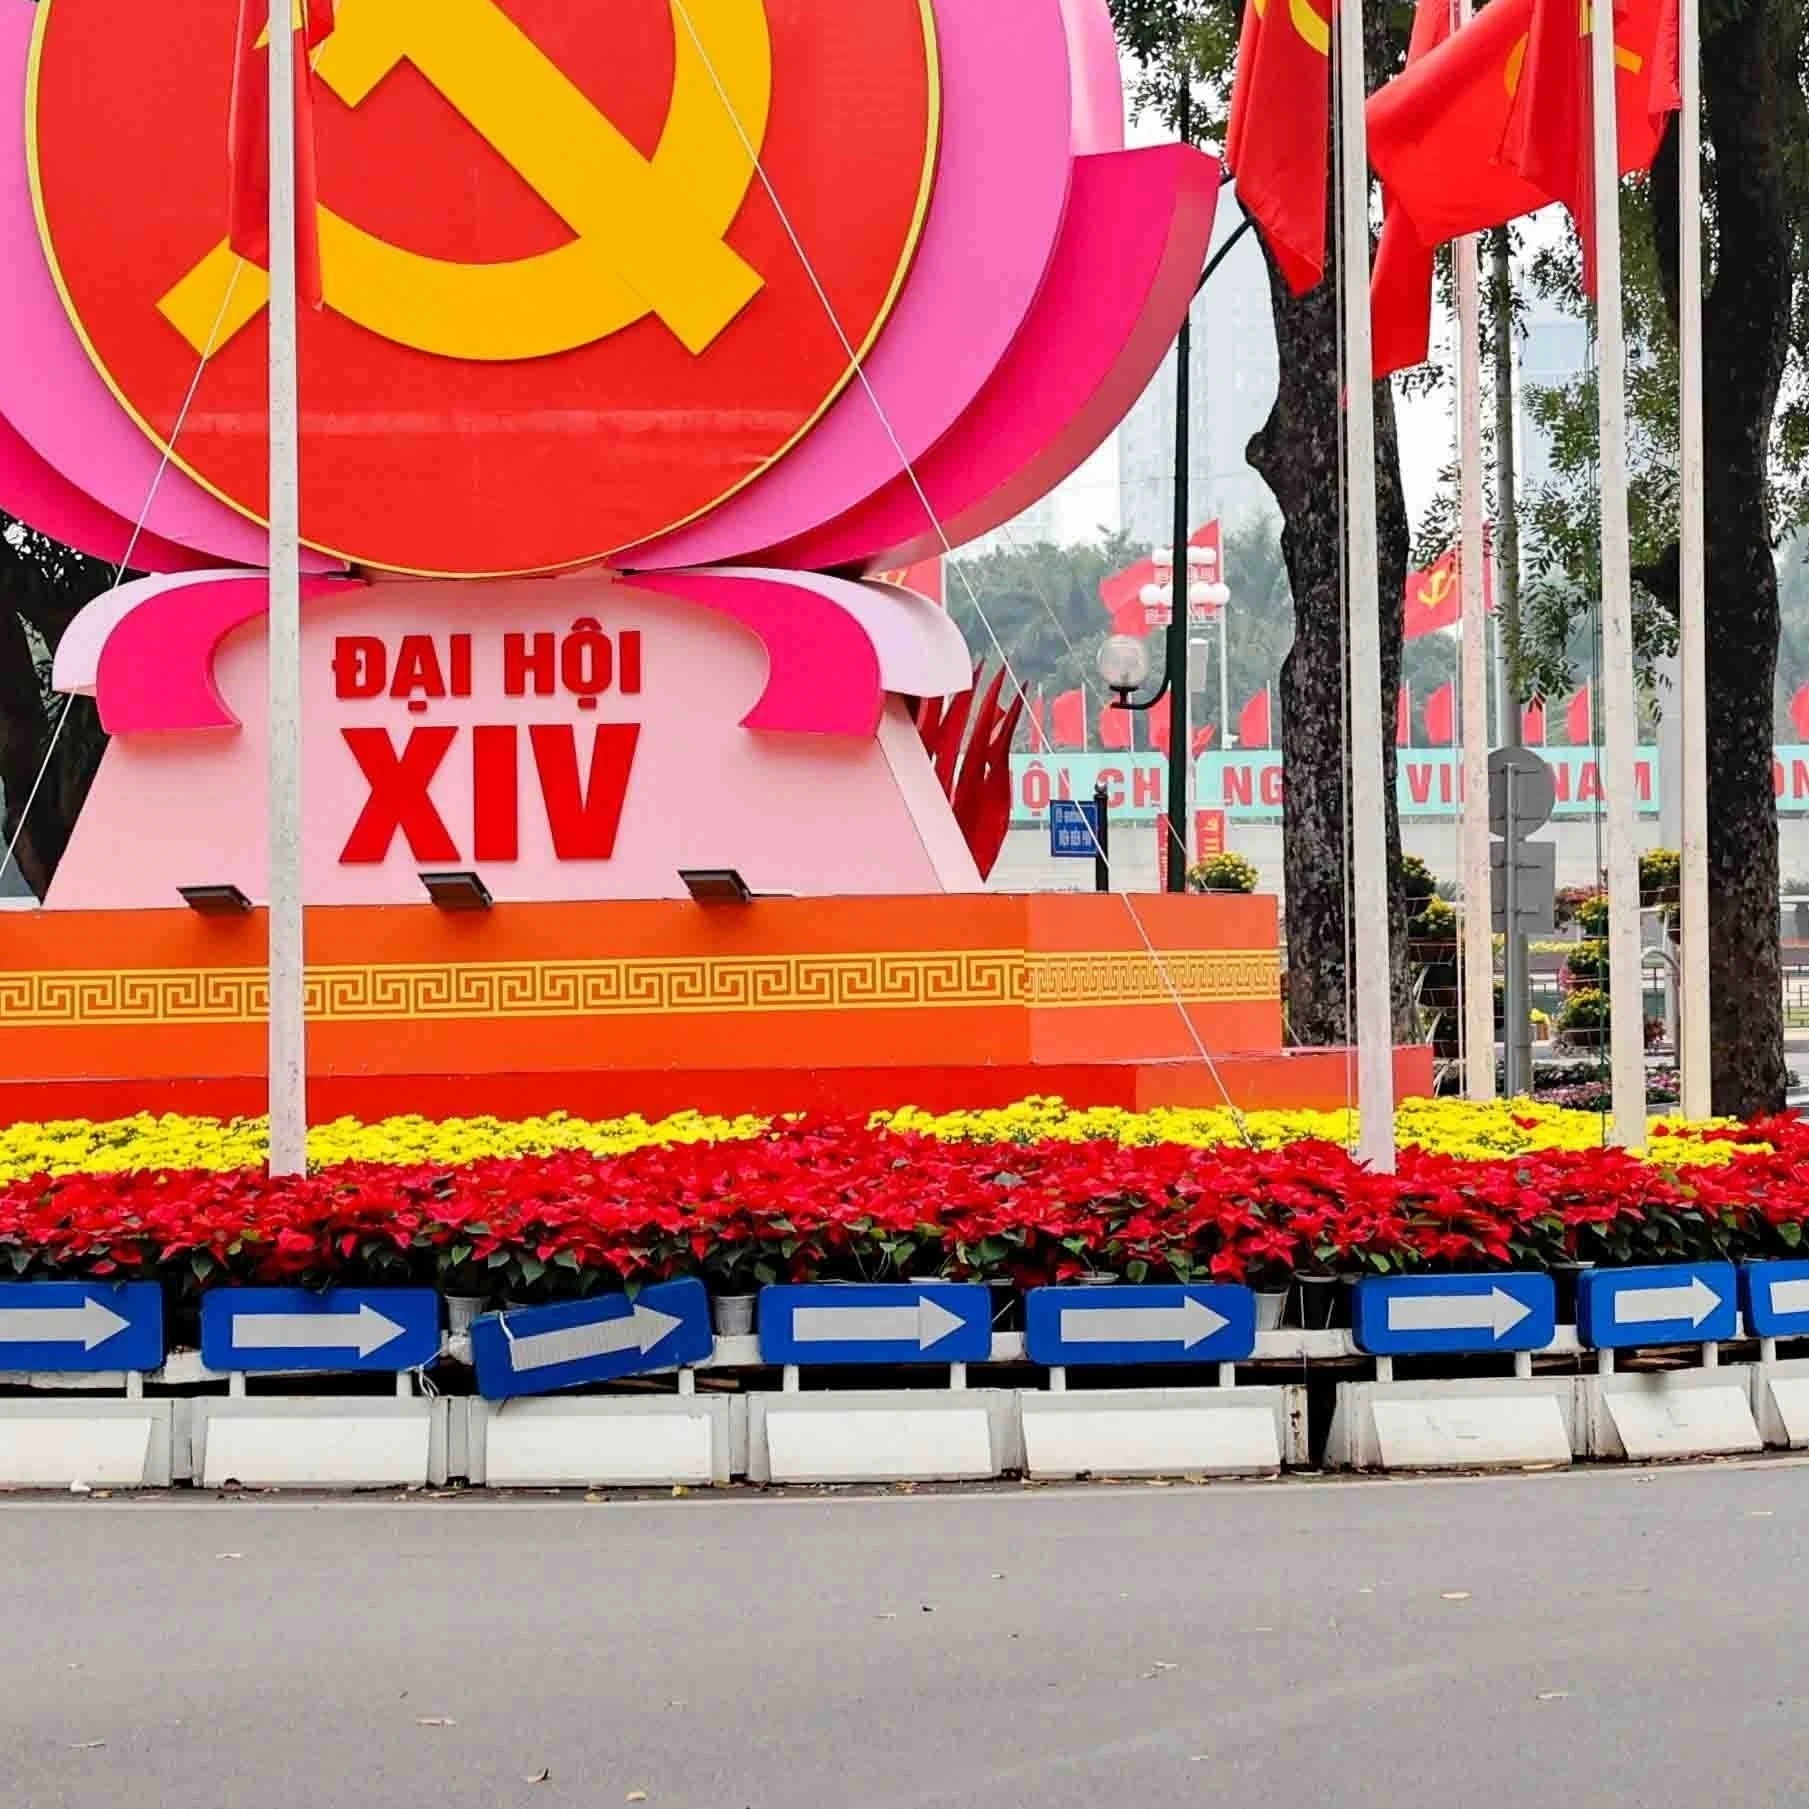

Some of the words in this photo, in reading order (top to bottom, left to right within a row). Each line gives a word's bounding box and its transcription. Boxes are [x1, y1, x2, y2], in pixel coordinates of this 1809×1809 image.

[331, 633, 472, 713] ĐẠI
[503, 617, 641, 710] HỘI
[338, 722, 641, 863] XIV
[1009, 759, 1071, 817] ỘI
